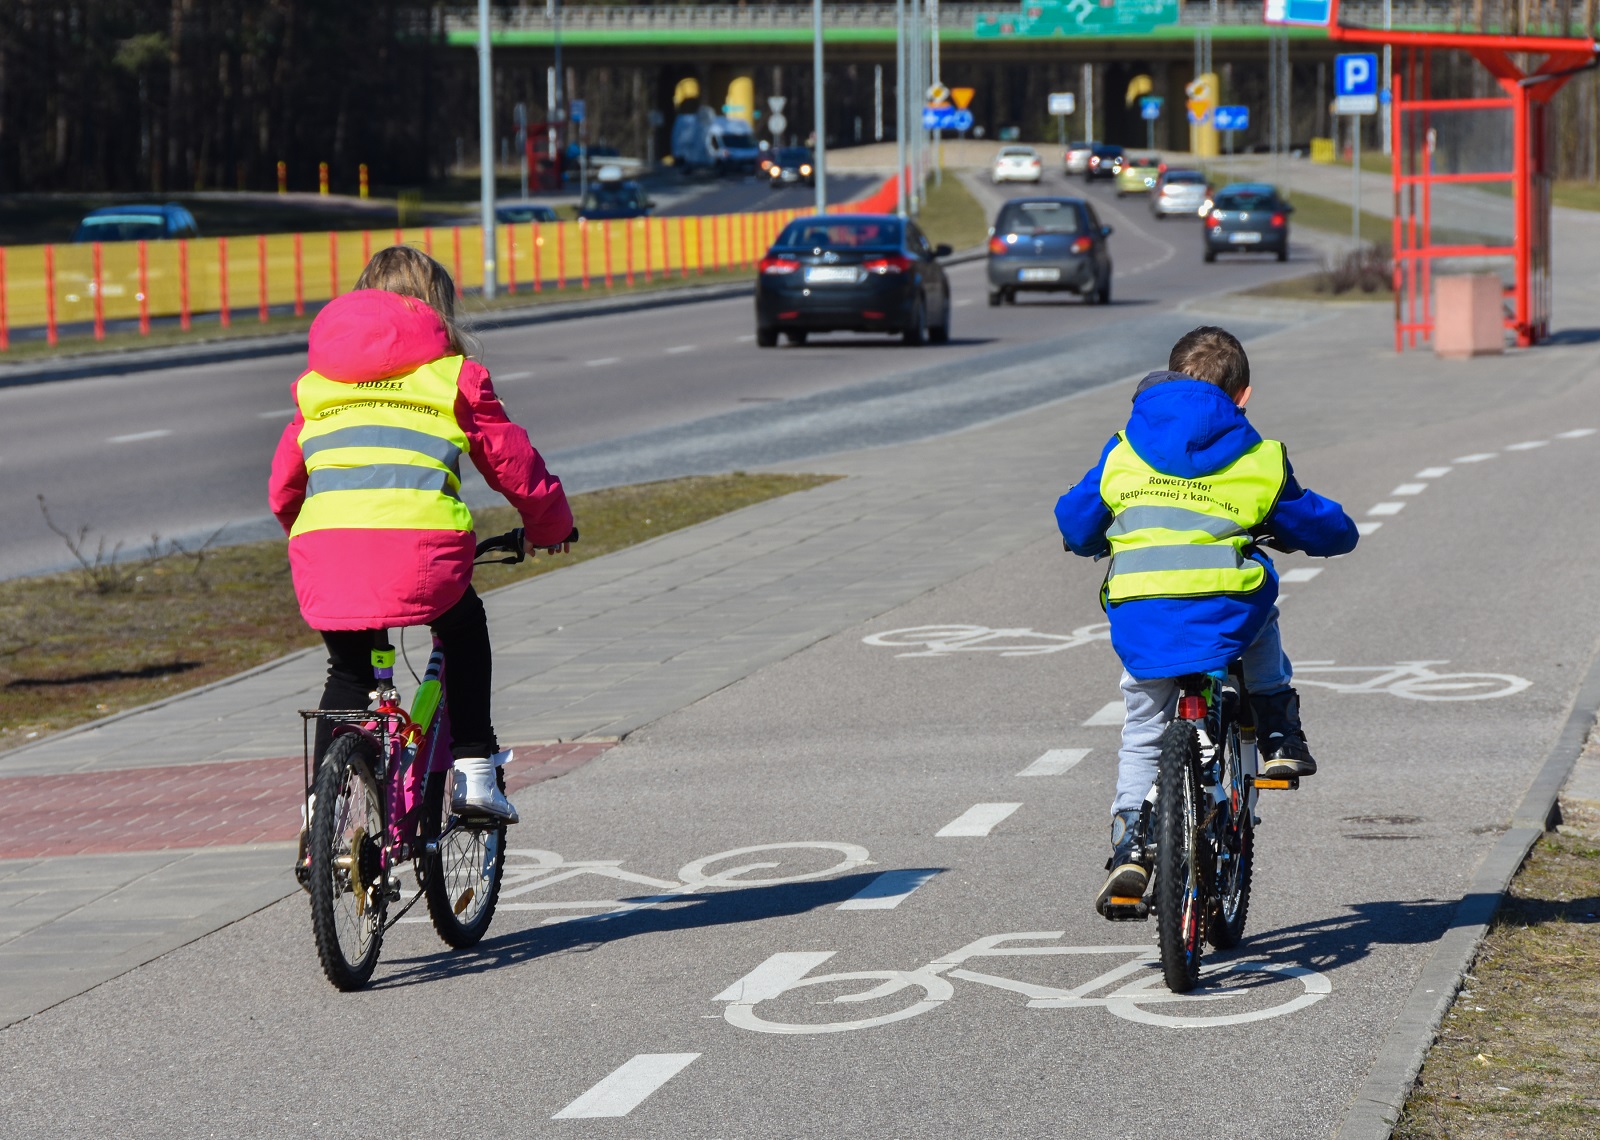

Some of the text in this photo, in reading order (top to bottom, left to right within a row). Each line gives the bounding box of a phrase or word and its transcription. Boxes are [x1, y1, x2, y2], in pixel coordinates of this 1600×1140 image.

[1344, 58, 1370, 91] P
[387, 401, 439, 417] kamizelką
[1148, 476, 1213, 493] Rowerzysto!
[1120, 488, 1181, 501] Bezpieczniej
[1190, 491, 1240, 516] kamlką
